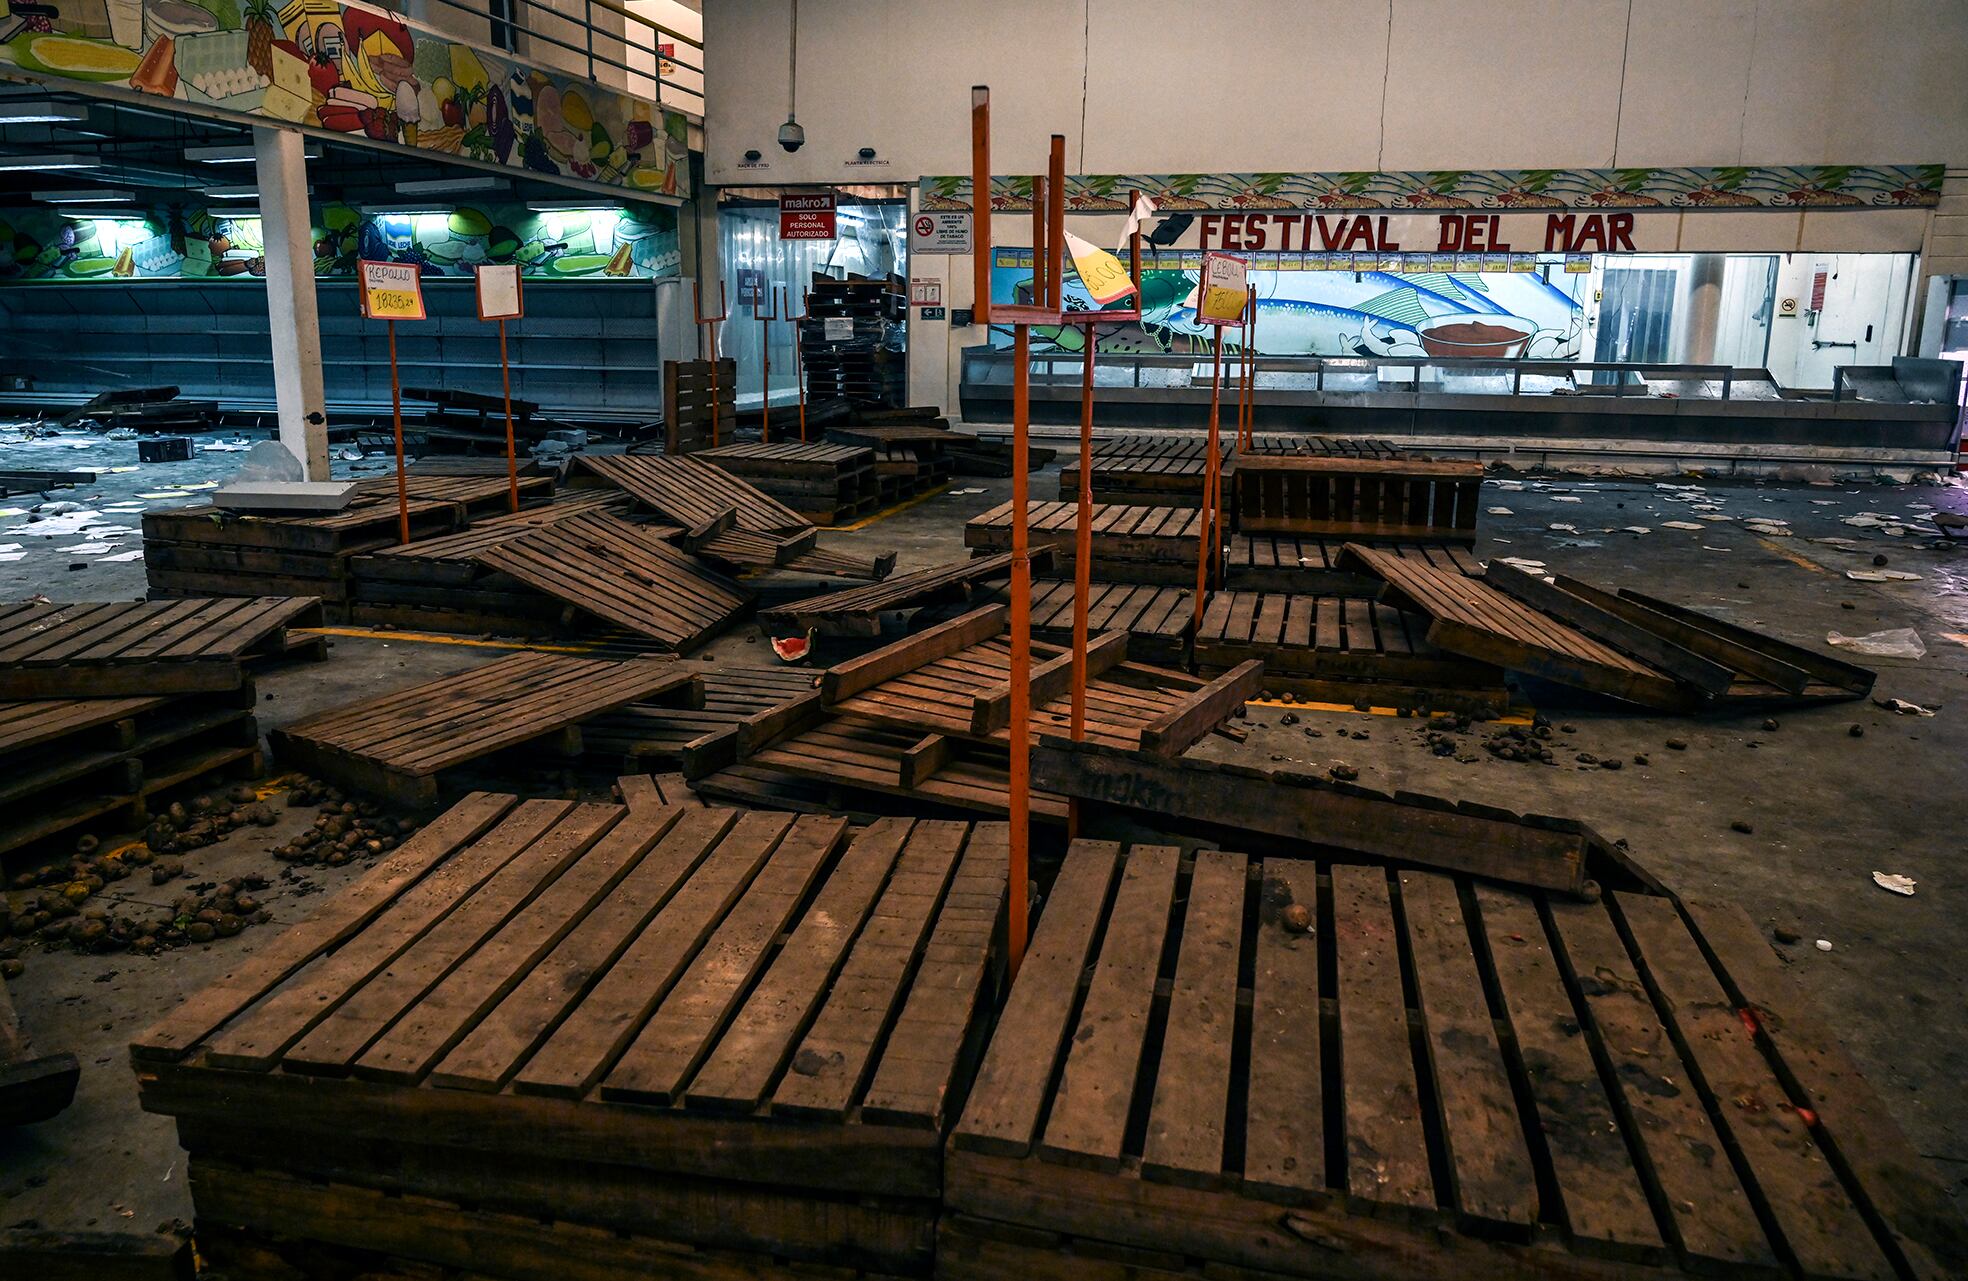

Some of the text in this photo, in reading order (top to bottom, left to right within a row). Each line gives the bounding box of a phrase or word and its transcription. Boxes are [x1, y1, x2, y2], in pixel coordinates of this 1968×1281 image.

[785, 198, 820, 209] makro
[1200, 213, 1636, 252] FESTIVAL DEL MAR
